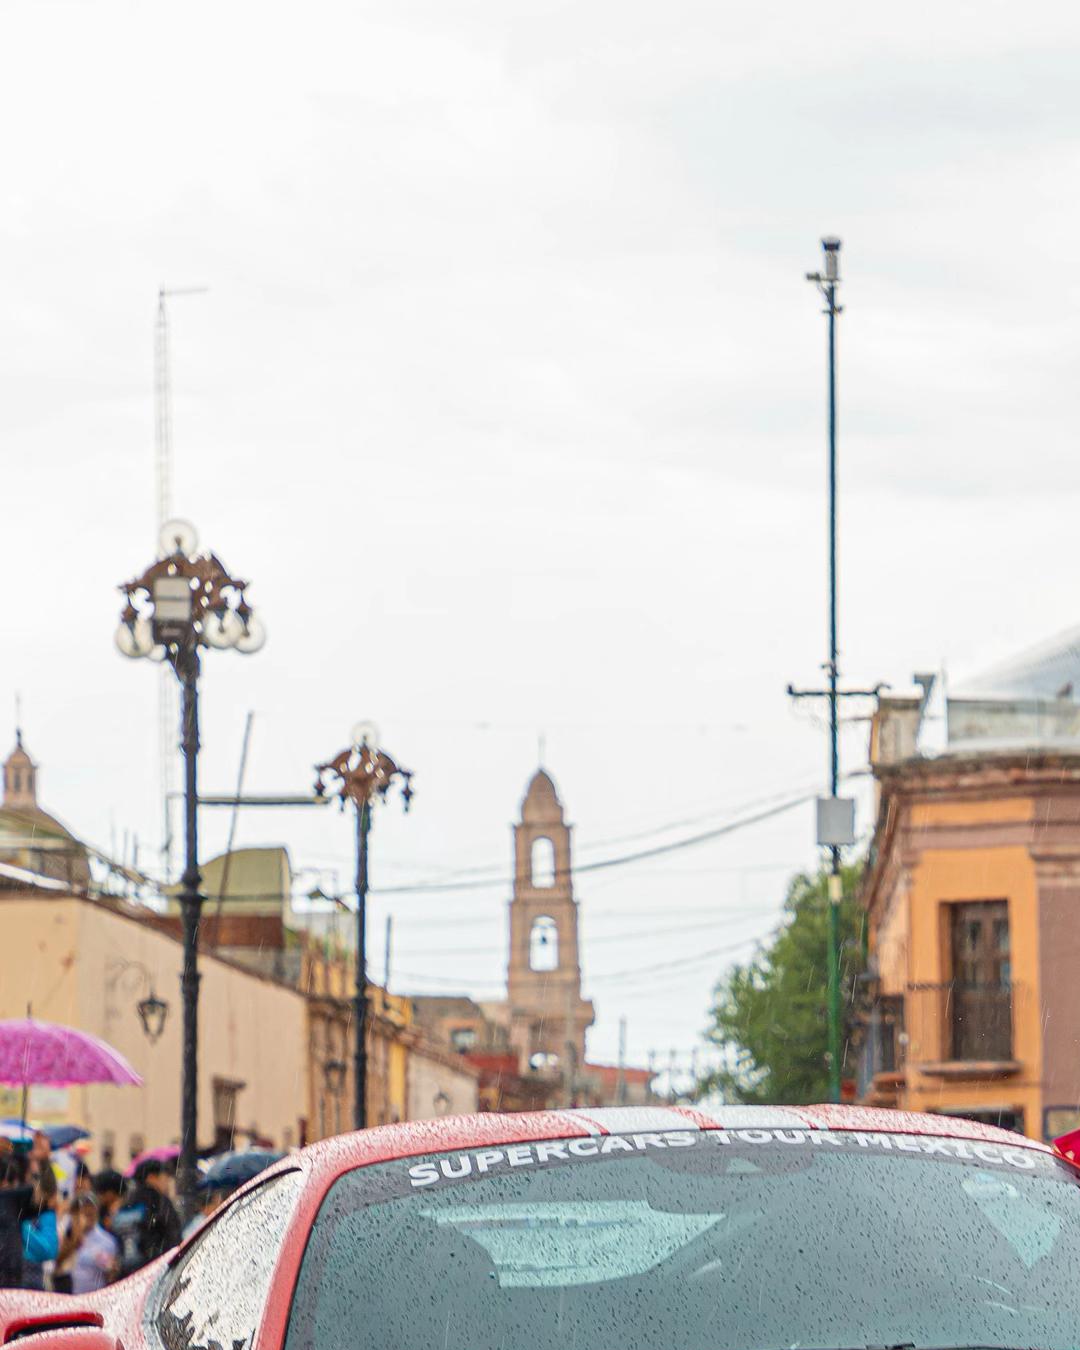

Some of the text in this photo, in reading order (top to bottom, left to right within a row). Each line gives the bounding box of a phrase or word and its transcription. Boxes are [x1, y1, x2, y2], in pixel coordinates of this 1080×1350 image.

[408, 1128, 1037, 1187] SUPERCARS TOUR MEXICO
